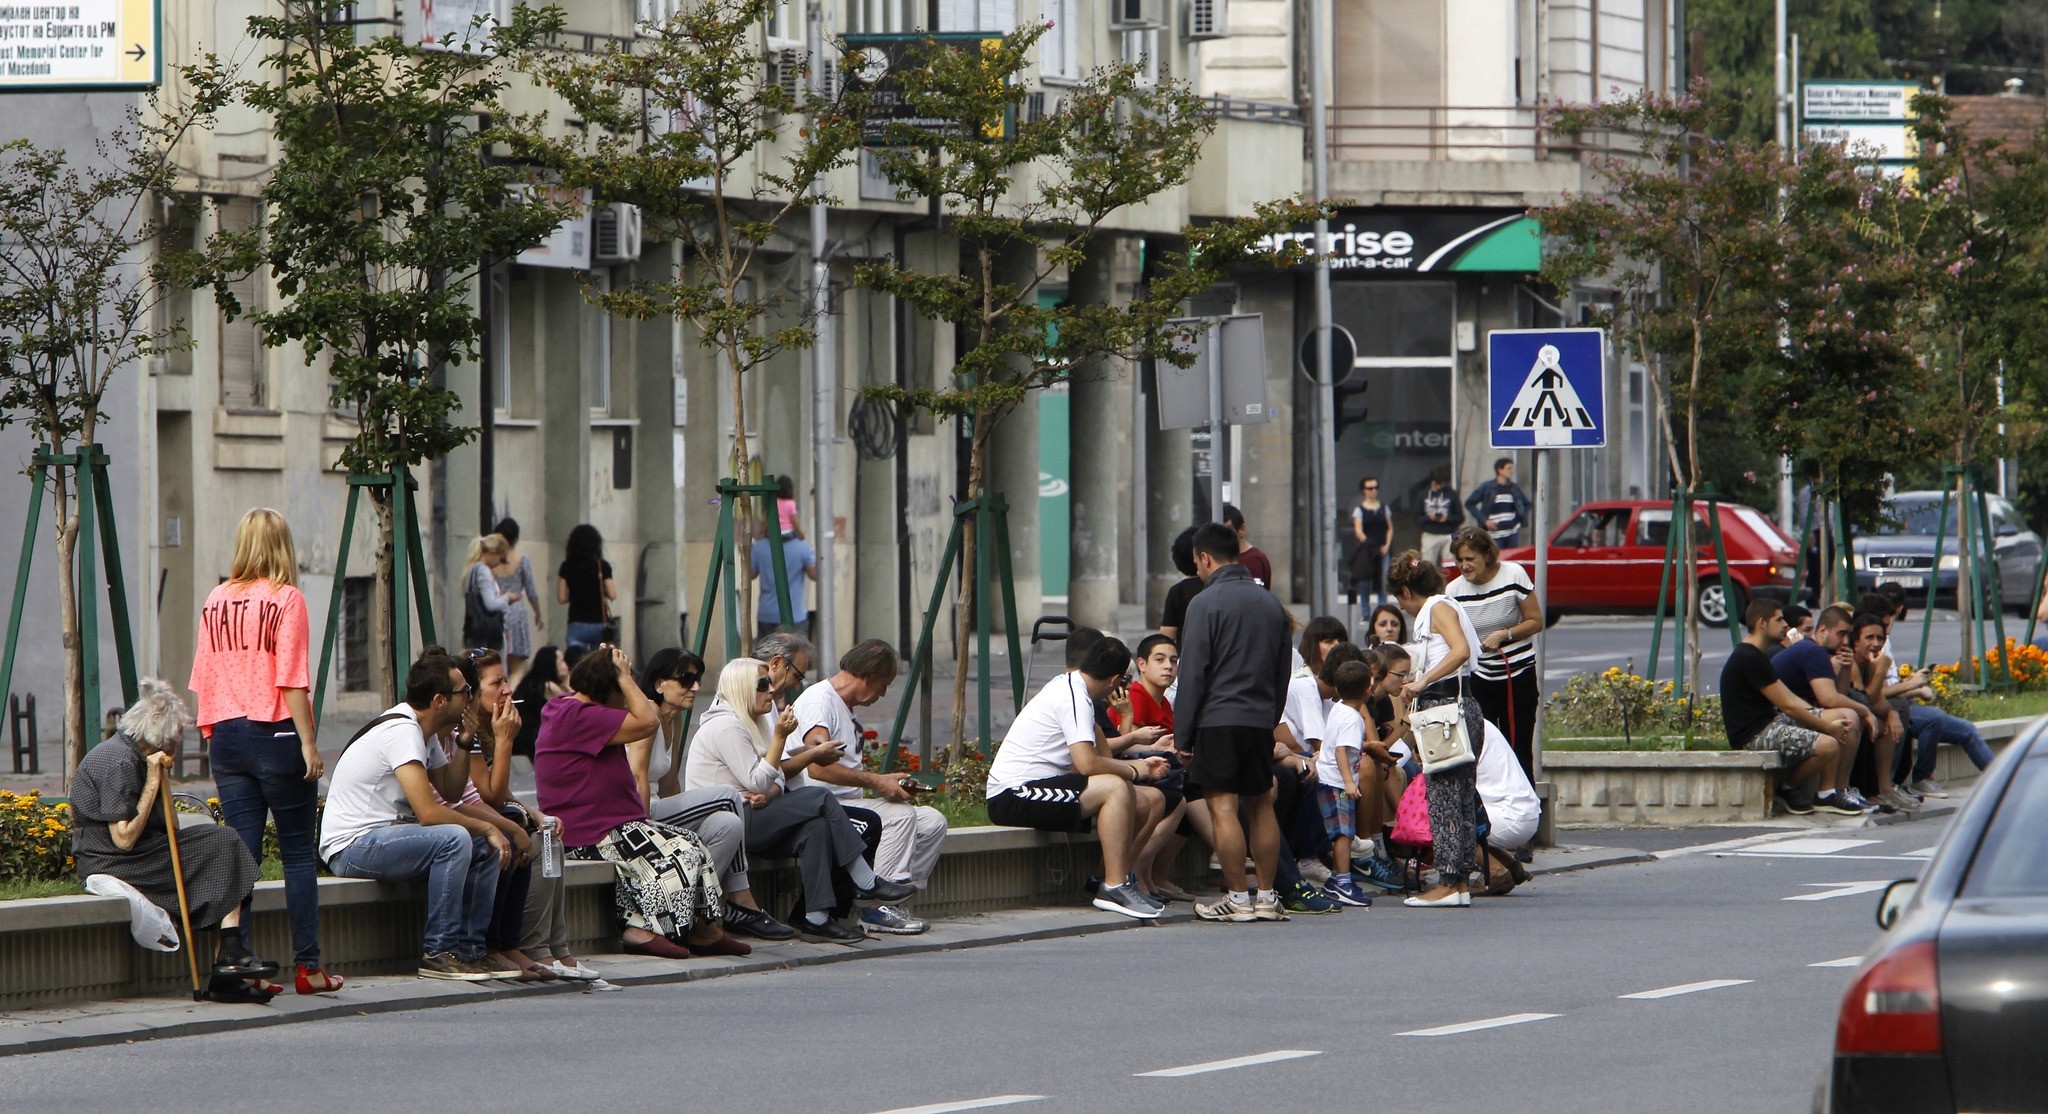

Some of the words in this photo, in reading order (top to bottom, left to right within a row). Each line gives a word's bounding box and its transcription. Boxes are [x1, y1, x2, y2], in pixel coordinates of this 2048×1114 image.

[33, 6, 66, 21] центар
[69, 6, 79, 19] на
[33, 25, 43, 38] на
[46, 22, 84, 40] Евреите
[87, 25, 98, 38] од
[101, 22, 116, 38] РМ
[17, 44, 57, 59] Memorial
[60, 44, 88, 59] Center
[91, 44, 103, 58] for
[8, 61, 51, 75] Macedonia
[1329, 256, 1413, 269] ent-a-car
